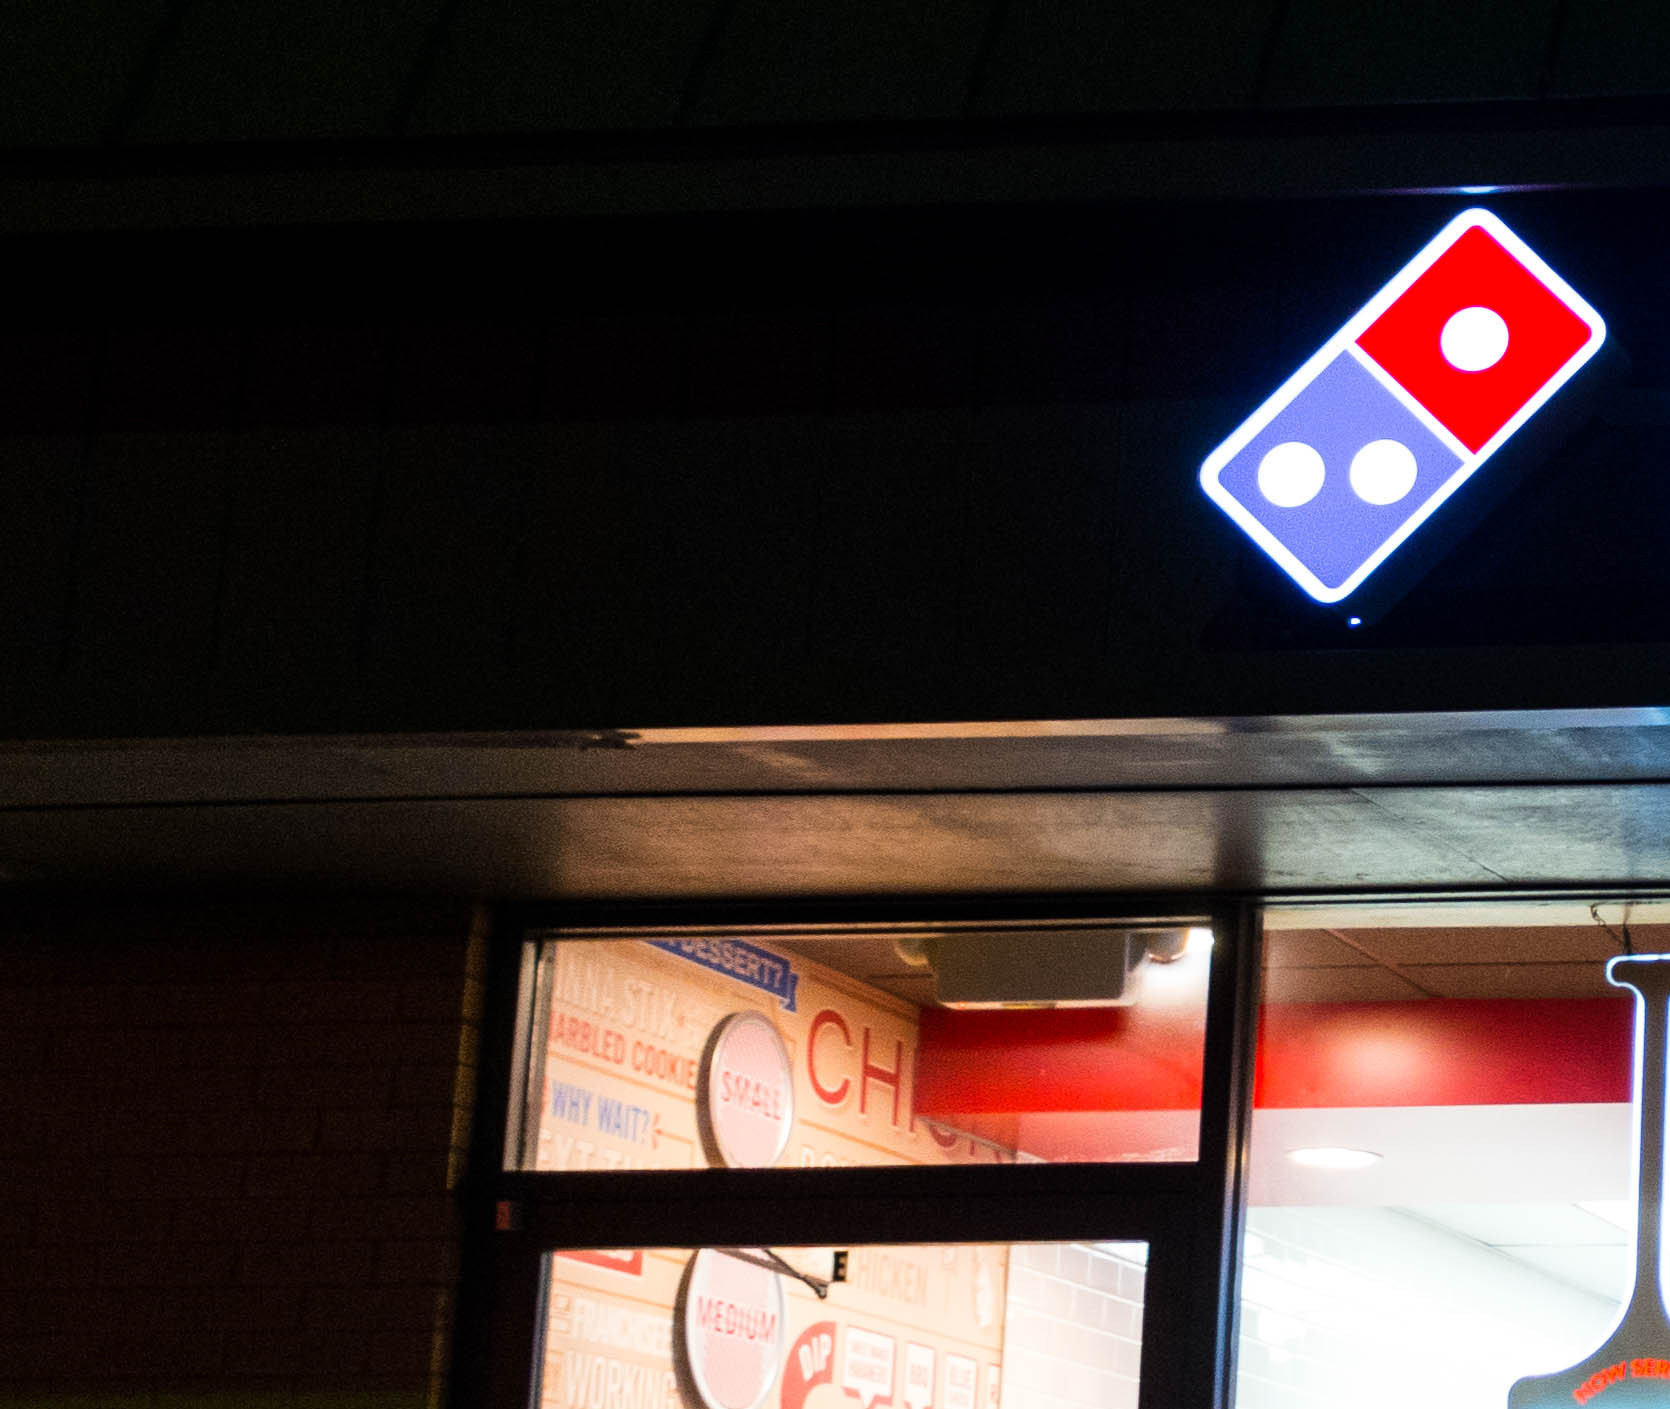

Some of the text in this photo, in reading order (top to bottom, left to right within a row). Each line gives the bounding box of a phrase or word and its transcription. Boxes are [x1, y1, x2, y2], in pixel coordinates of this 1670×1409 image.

[551, 1079, 650, 1145] WHY WAIT?
[721, 1068, 782, 1122] SMALL
[696, 1293, 777, 1346] MEDIUM
[799, 1333, 833, 1380] DIP
[1572, 1360, 1627, 1405] NOW
